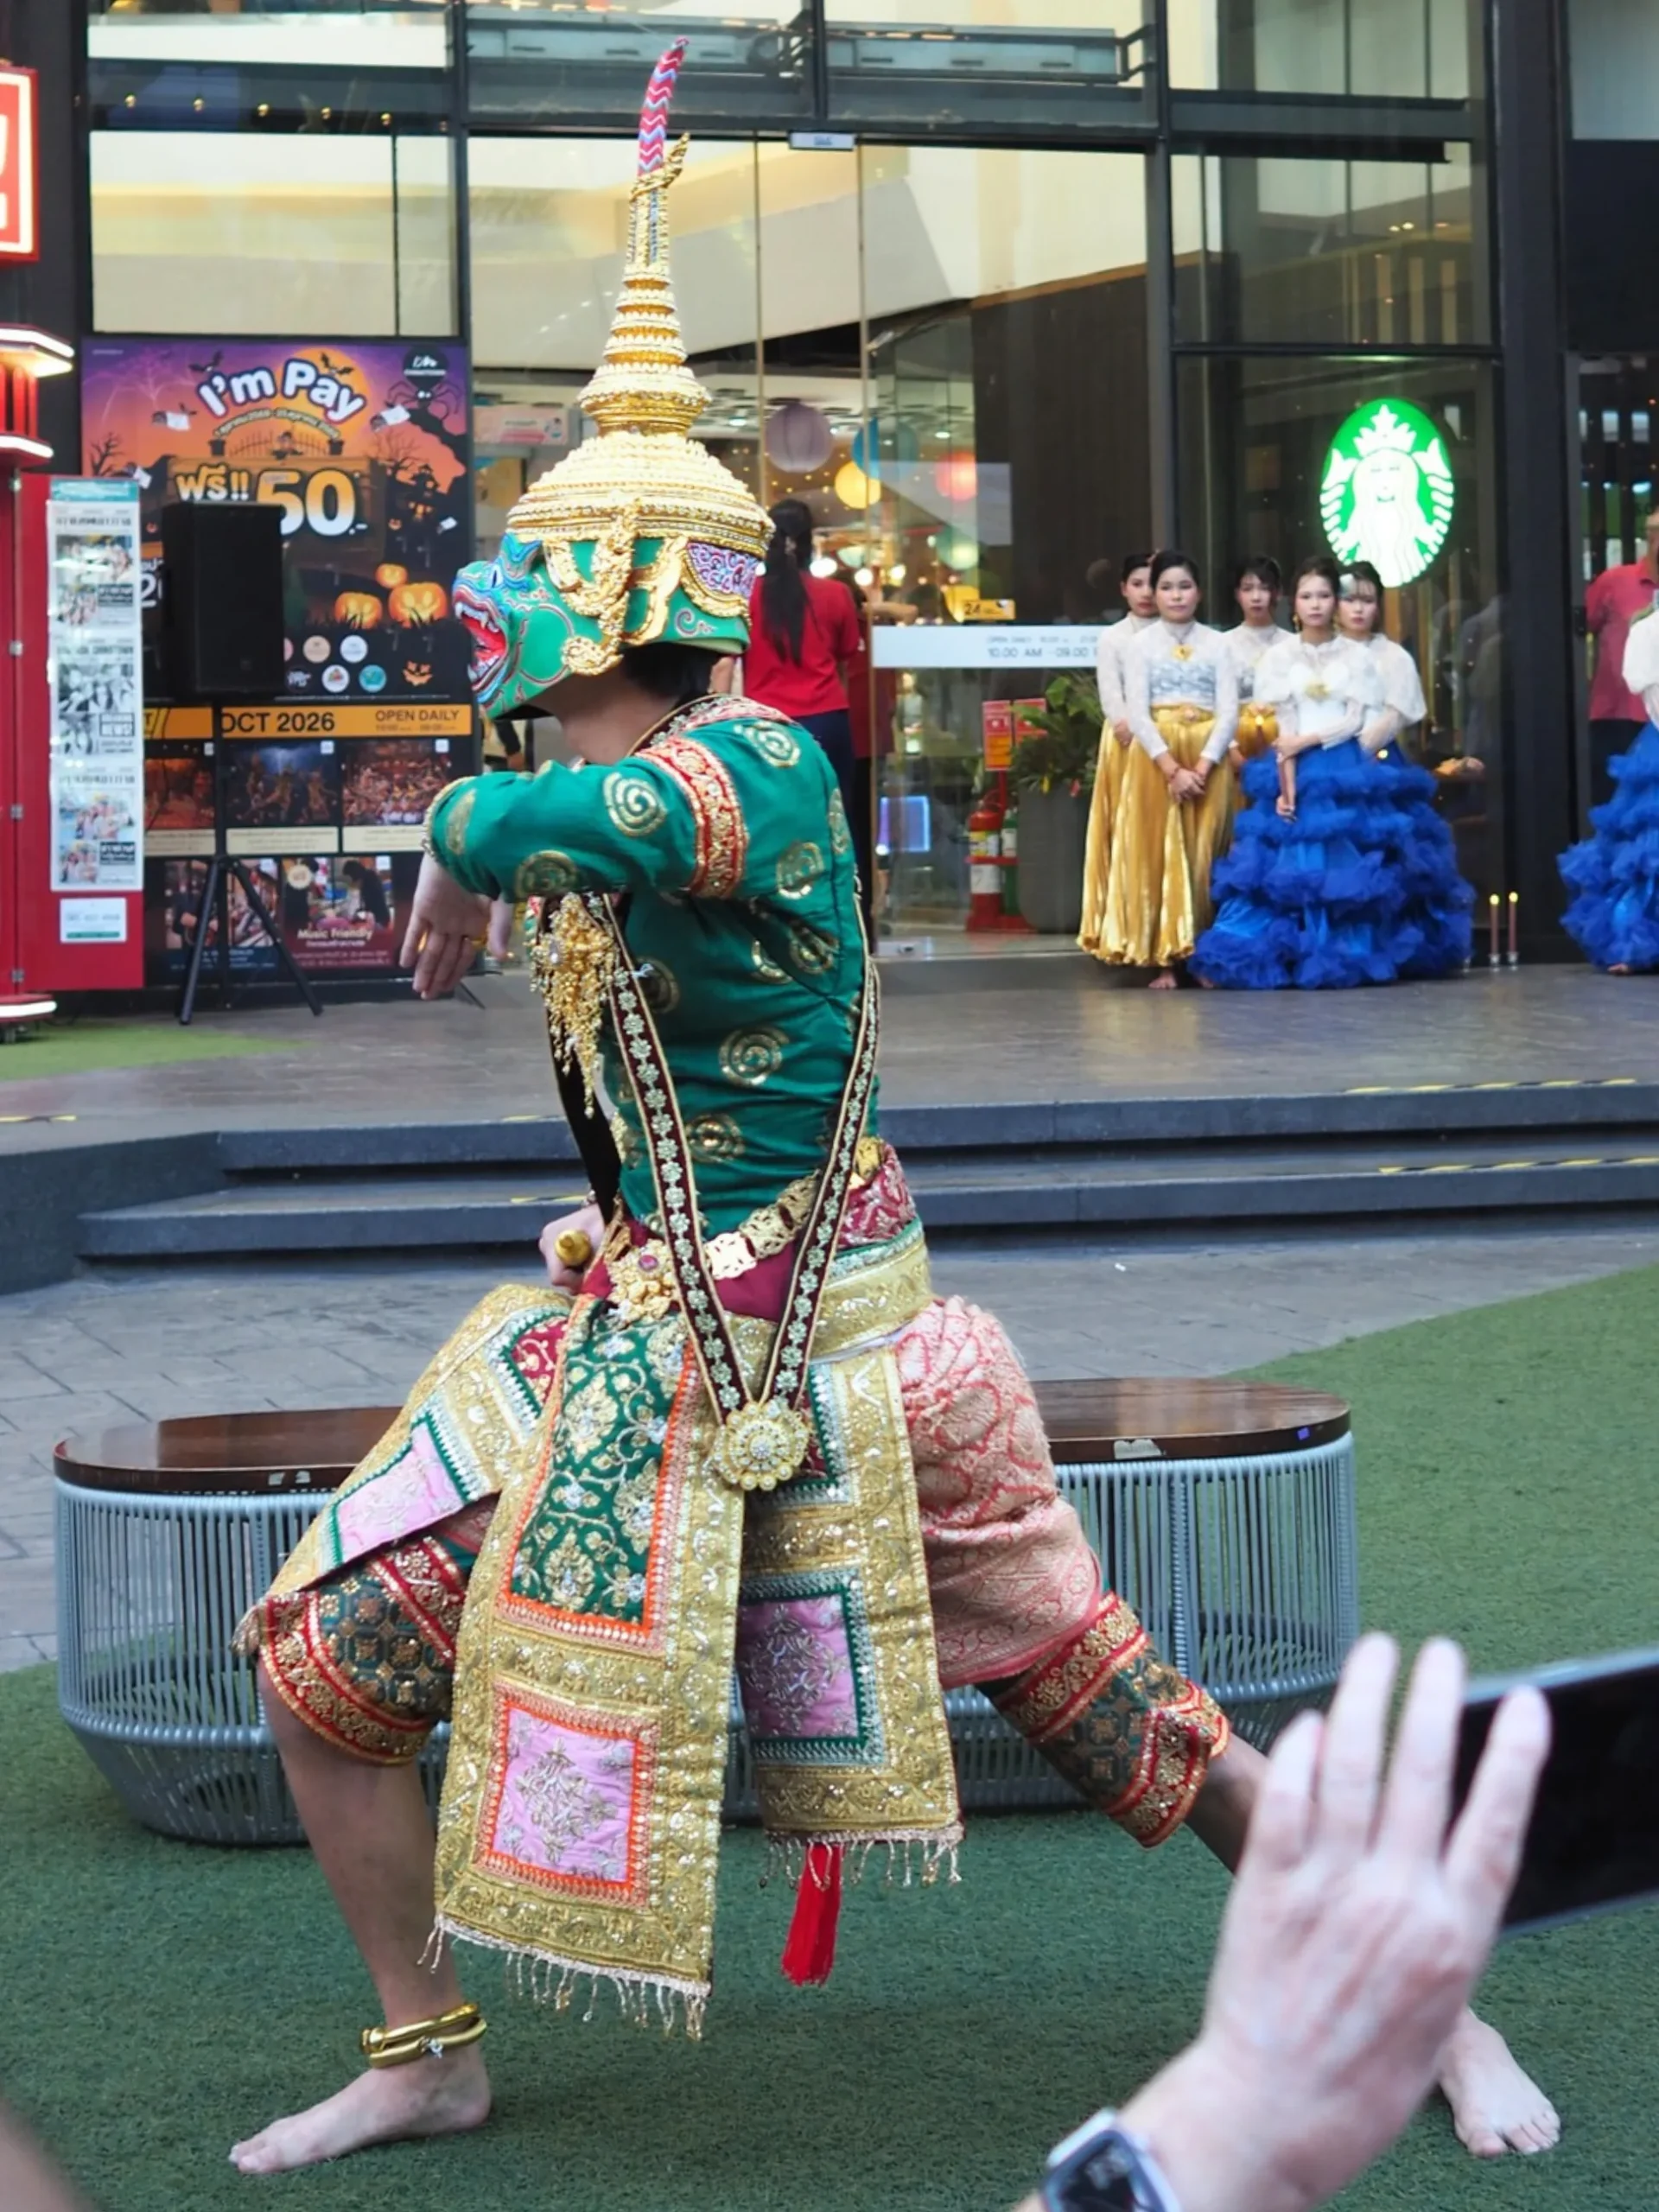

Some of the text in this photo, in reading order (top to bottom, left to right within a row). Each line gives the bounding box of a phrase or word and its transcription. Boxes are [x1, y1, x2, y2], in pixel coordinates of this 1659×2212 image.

[199, 369, 276, 416] I'm
[283, 360, 365, 423] Pay
[222, 712, 334, 733] OCT 2026
[375, 709, 460, 722] OPEN DAILY
